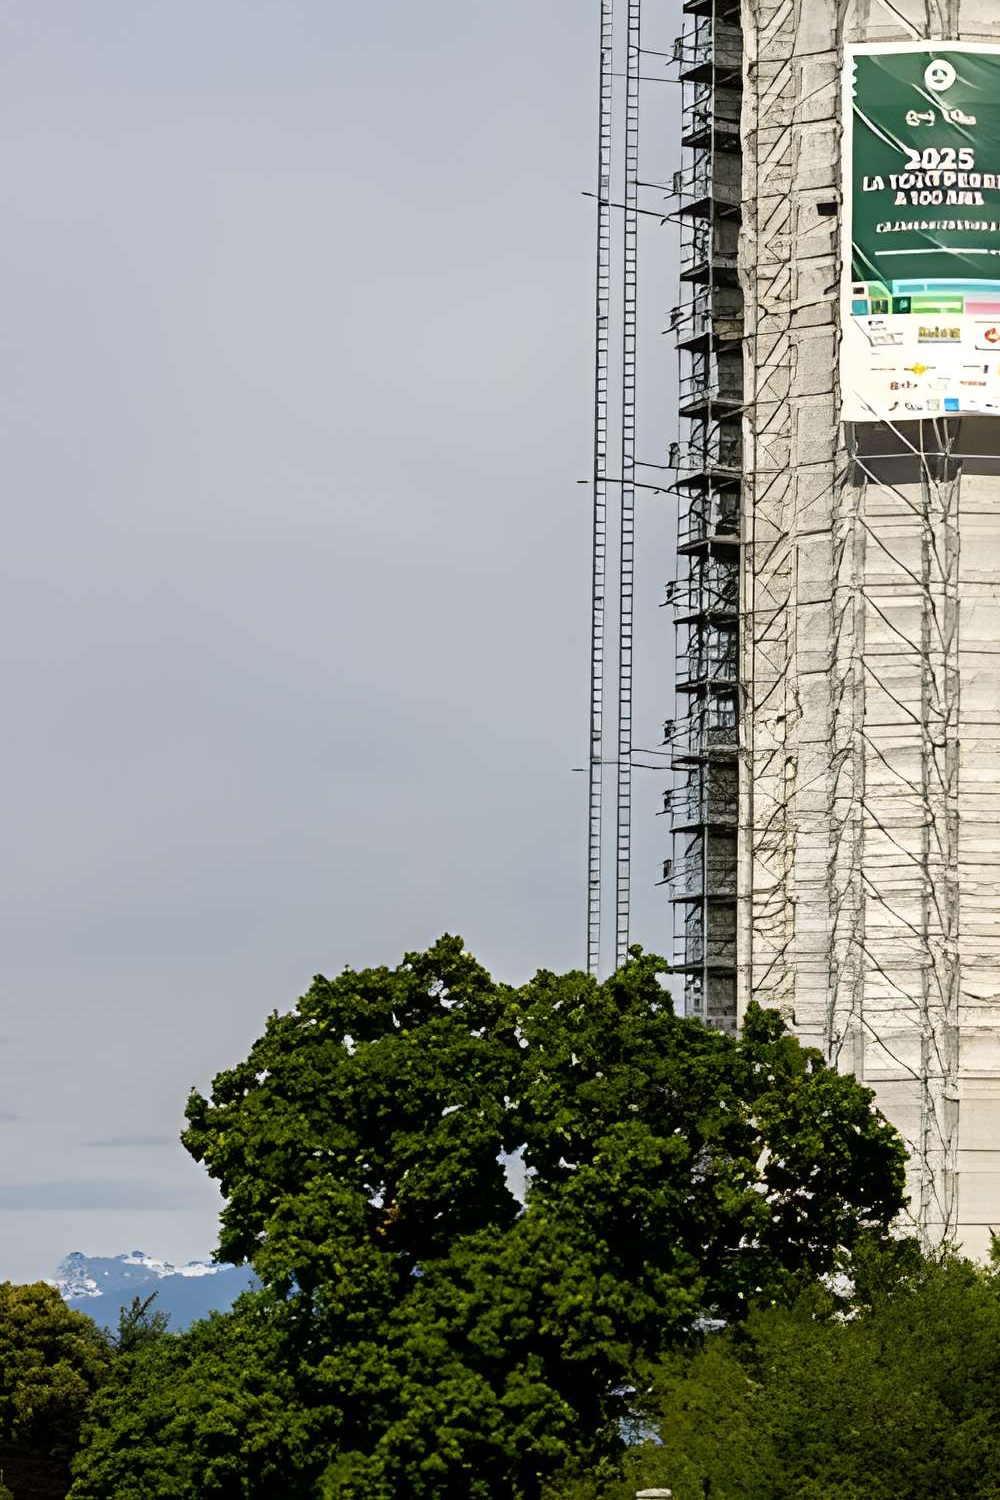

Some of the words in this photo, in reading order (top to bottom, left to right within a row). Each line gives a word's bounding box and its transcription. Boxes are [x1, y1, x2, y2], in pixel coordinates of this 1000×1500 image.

[904, 147, 975, 170] 2025
[862, 175, 885, 191] LA
[910, 190, 943, 206] 100
